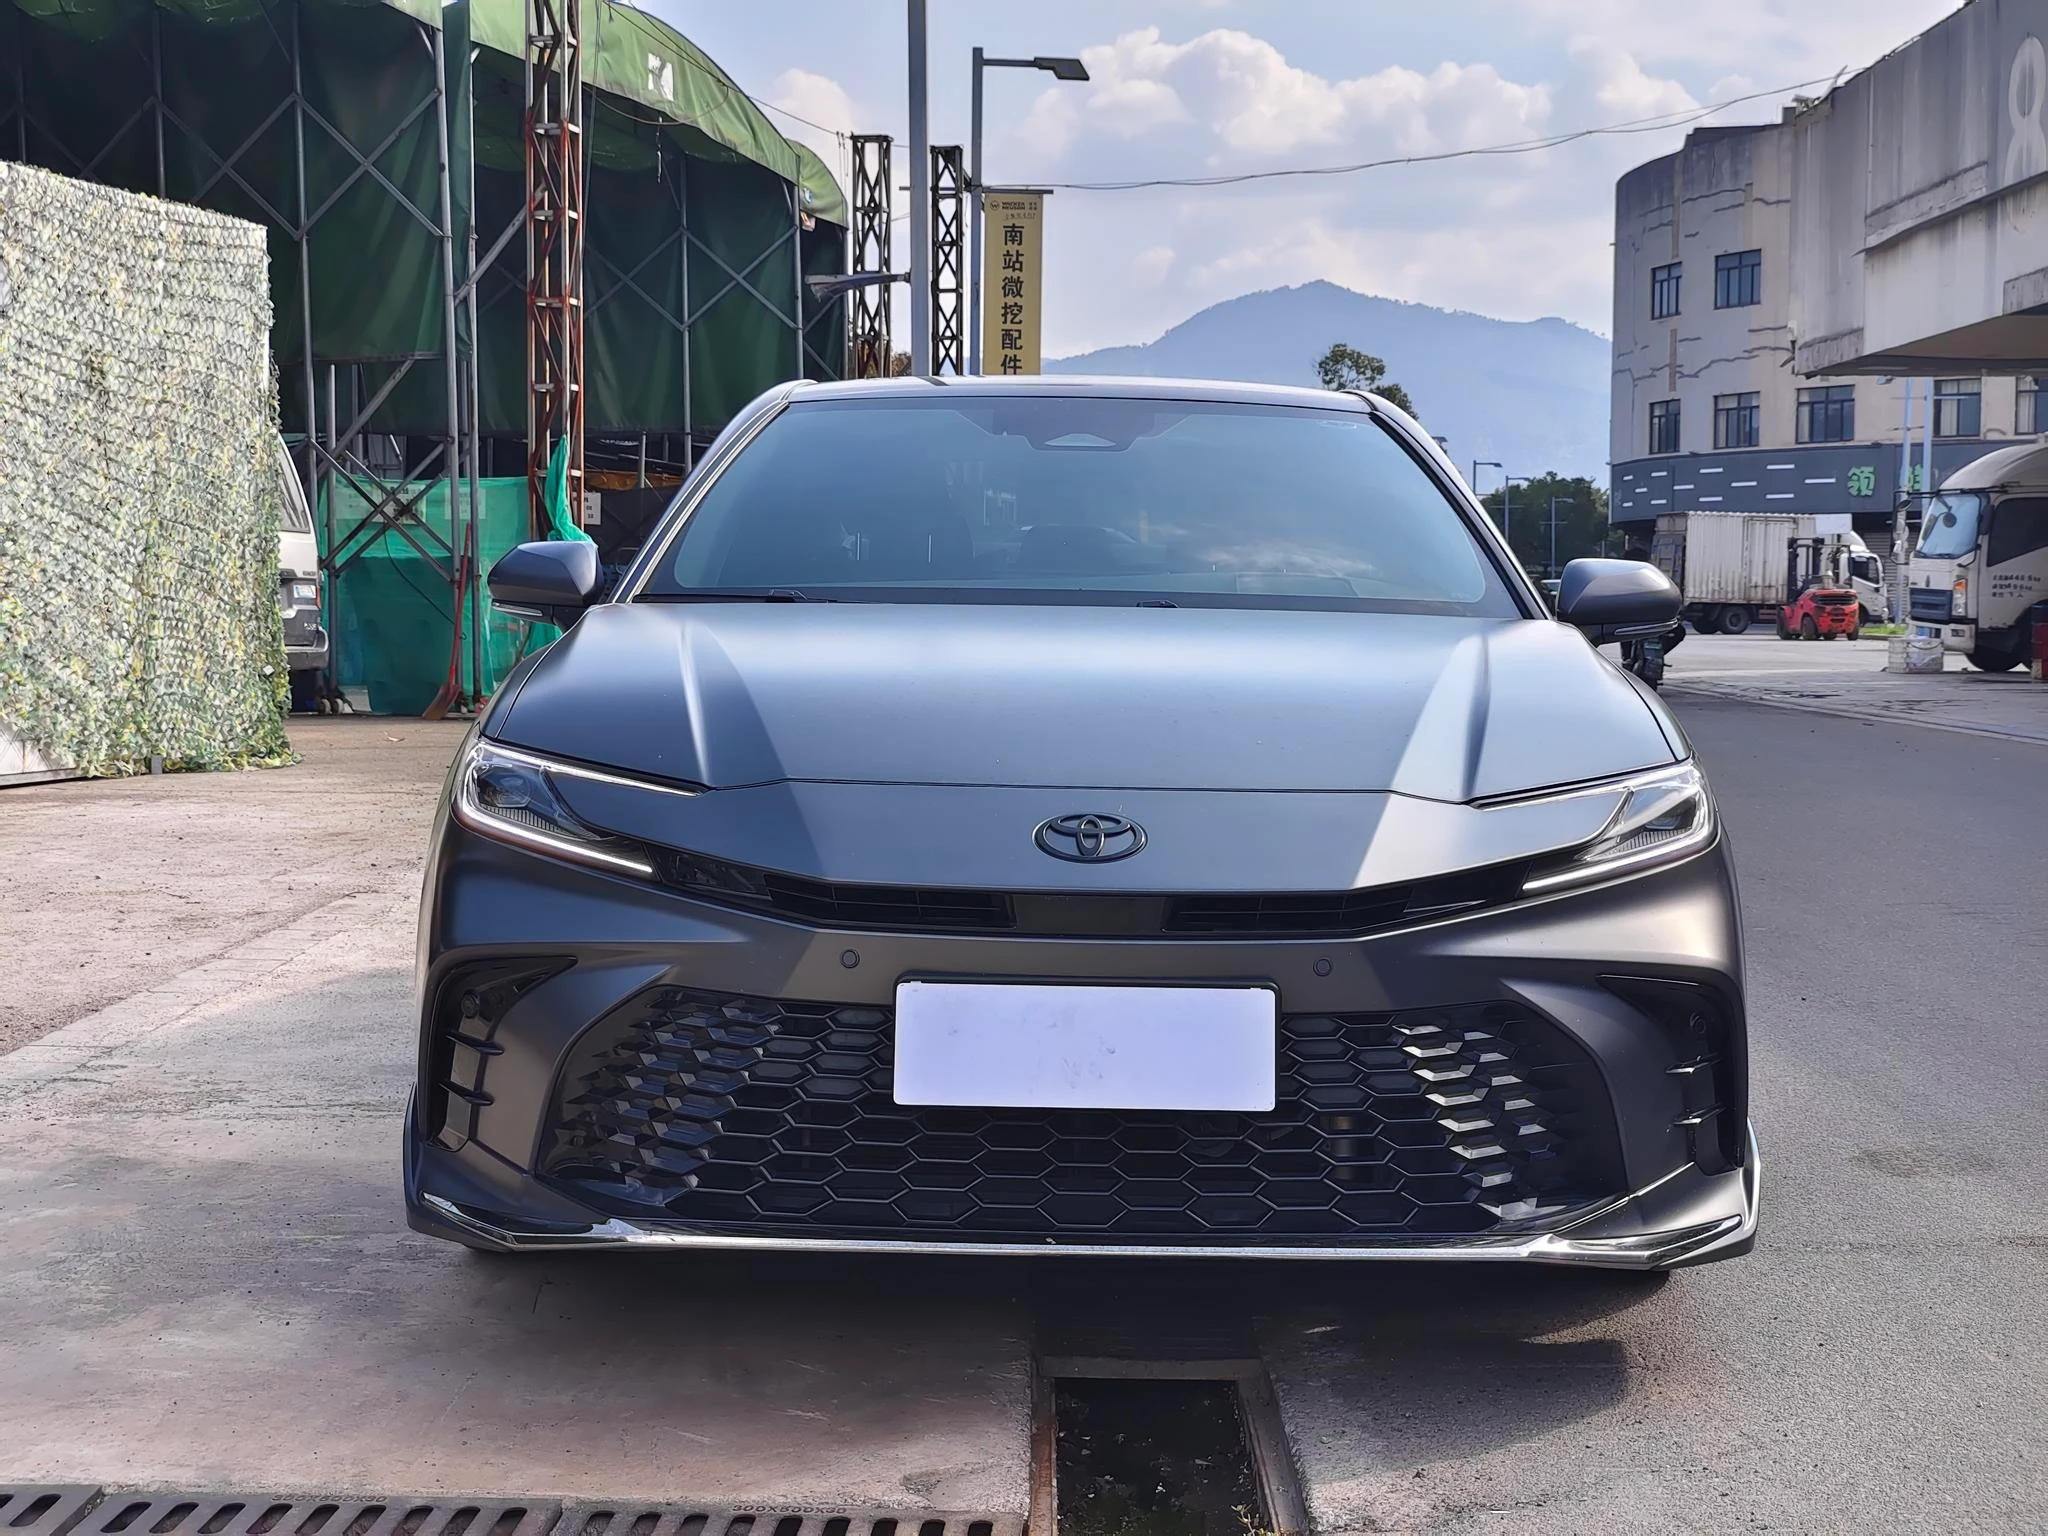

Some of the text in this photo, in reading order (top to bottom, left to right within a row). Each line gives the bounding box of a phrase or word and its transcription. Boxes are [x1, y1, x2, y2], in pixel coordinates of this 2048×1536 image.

[1000, 223, 1025, 375] 南站微挖配件
